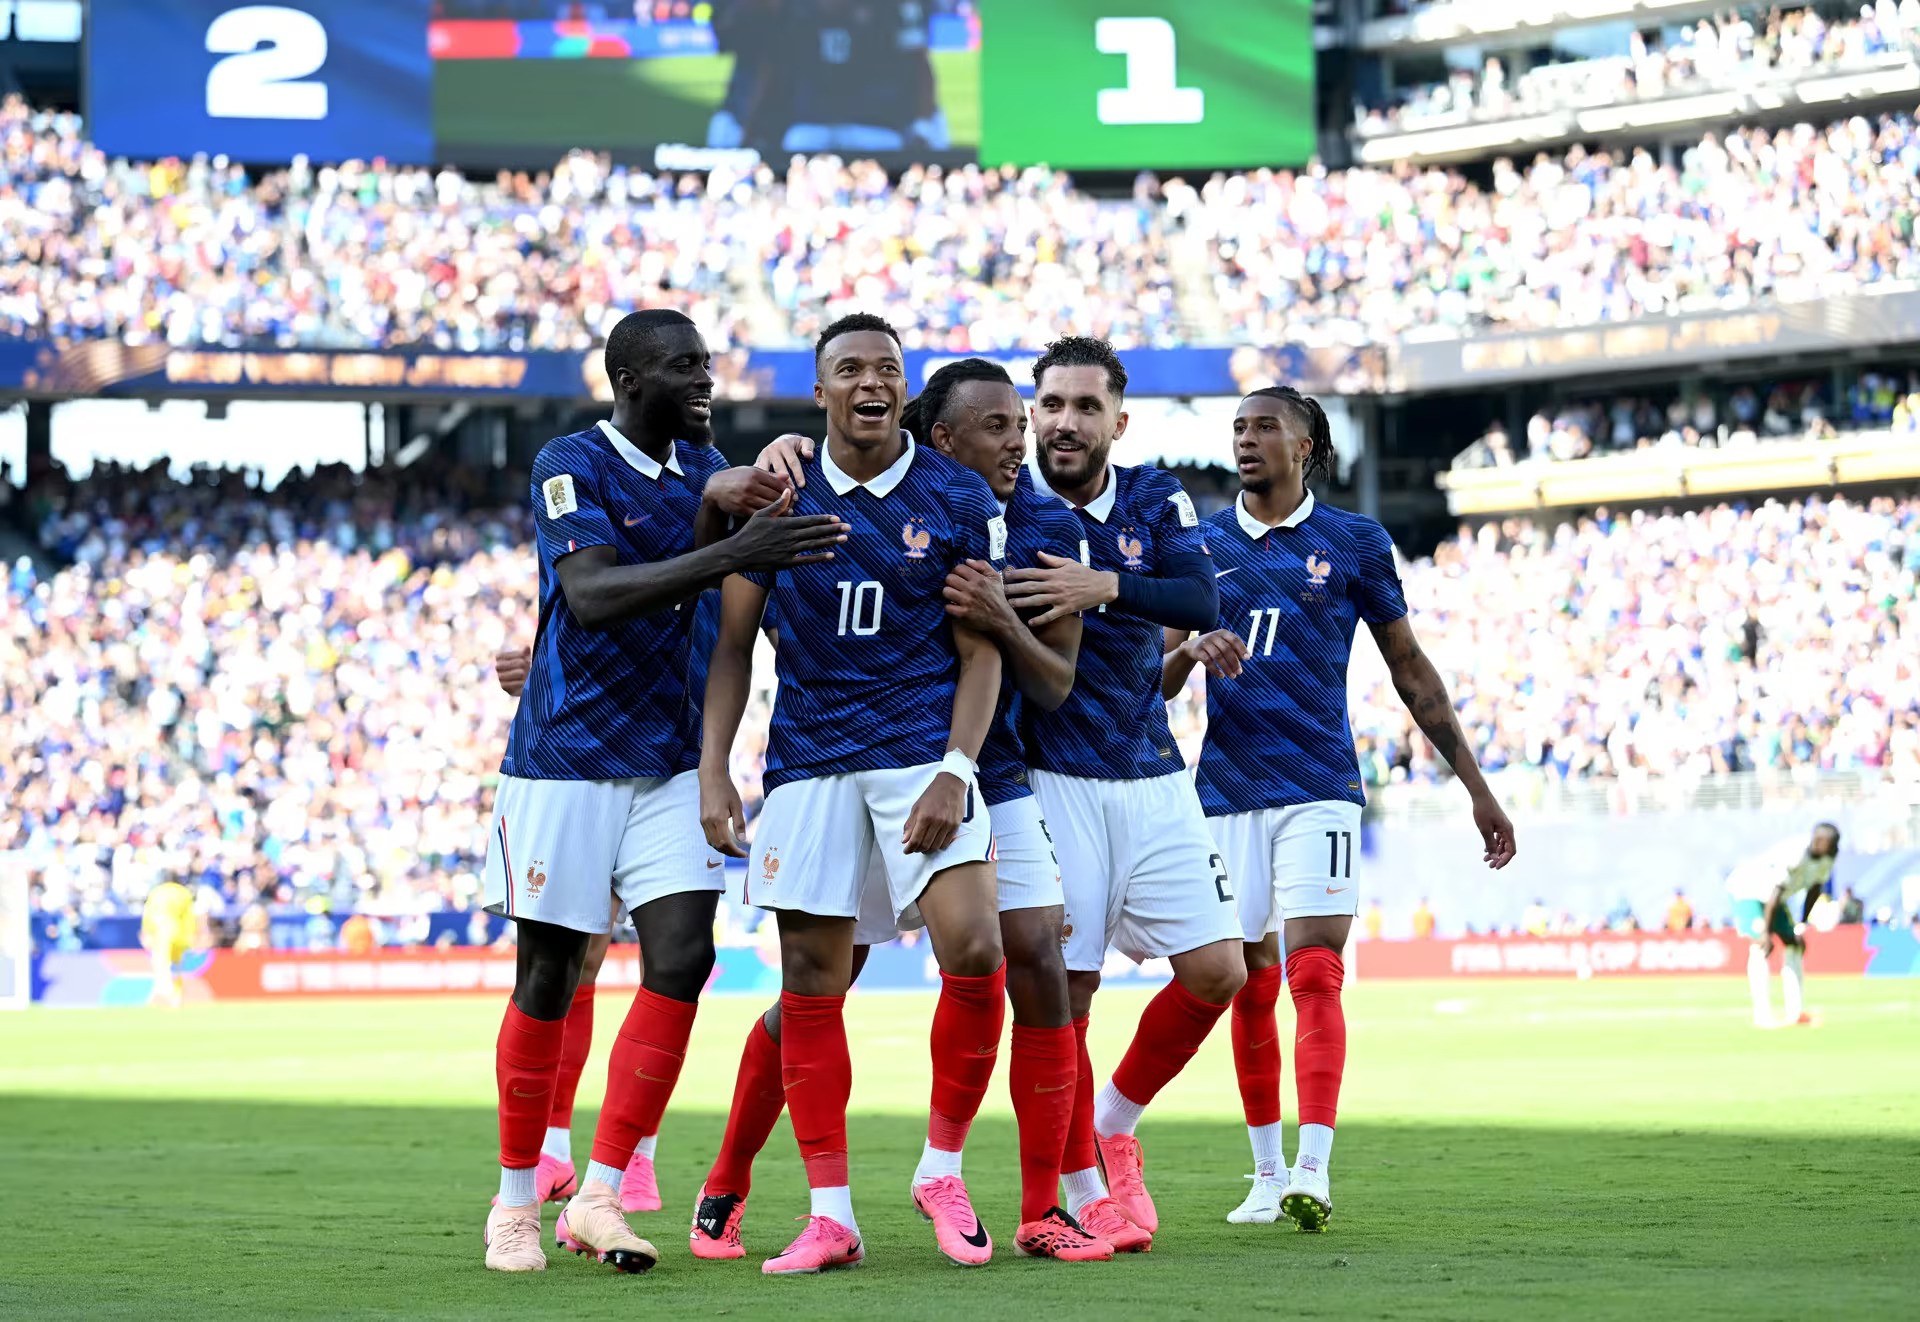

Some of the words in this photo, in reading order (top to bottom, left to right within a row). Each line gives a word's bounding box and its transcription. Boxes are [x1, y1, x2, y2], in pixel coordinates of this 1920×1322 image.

[205, 5, 328, 120] 2
[1096, 17, 1204, 125] 1
[837, 581, 884, 636] 10
[1247, 608, 1280, 657] 11
[1326, 831, 1351, 878] 11
